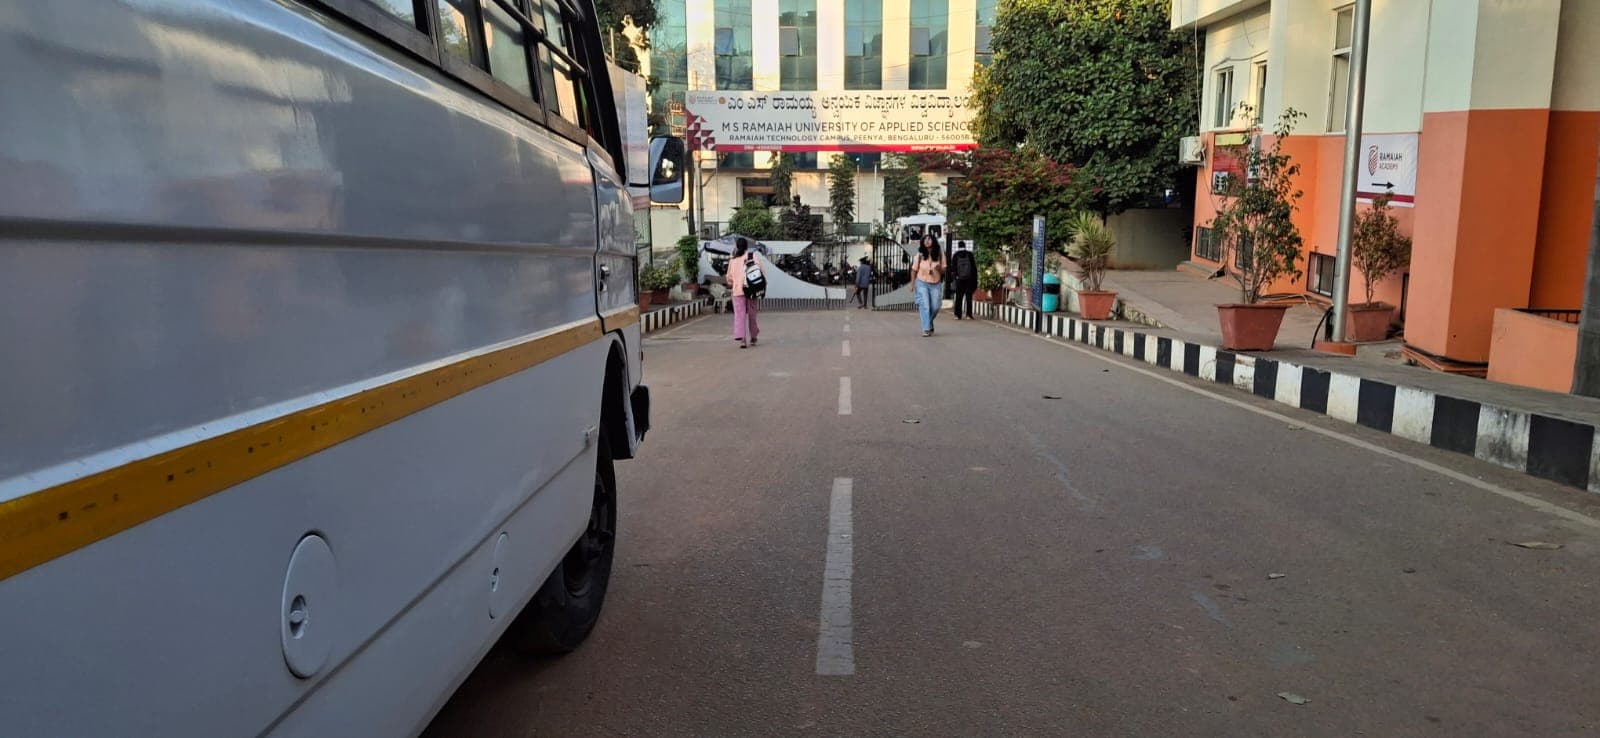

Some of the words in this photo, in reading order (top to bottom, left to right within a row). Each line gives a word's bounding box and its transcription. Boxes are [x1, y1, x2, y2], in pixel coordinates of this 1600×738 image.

[727, 97, 744, 110] ಎಂ
[747, 95, 768, 110] ಎಸ್
[772, 95, 817, 118] ರಾಮಯ್ಯ
[722, 122, 730, 132] M
[733, 122, 739, 132] S
[743, 122, 793, 132] RAMAIAH
[795, 122, 858, 132] UNIVERSITY
[860, 122, 875, 132] OF
[878, 122, 924, 132] APPLIED
[887, 134, 935, 142] BENGALURU
[1379, 152, 1403, 161] RAMAIAH
[1379, 162, 1399, 170] ACADEMY
